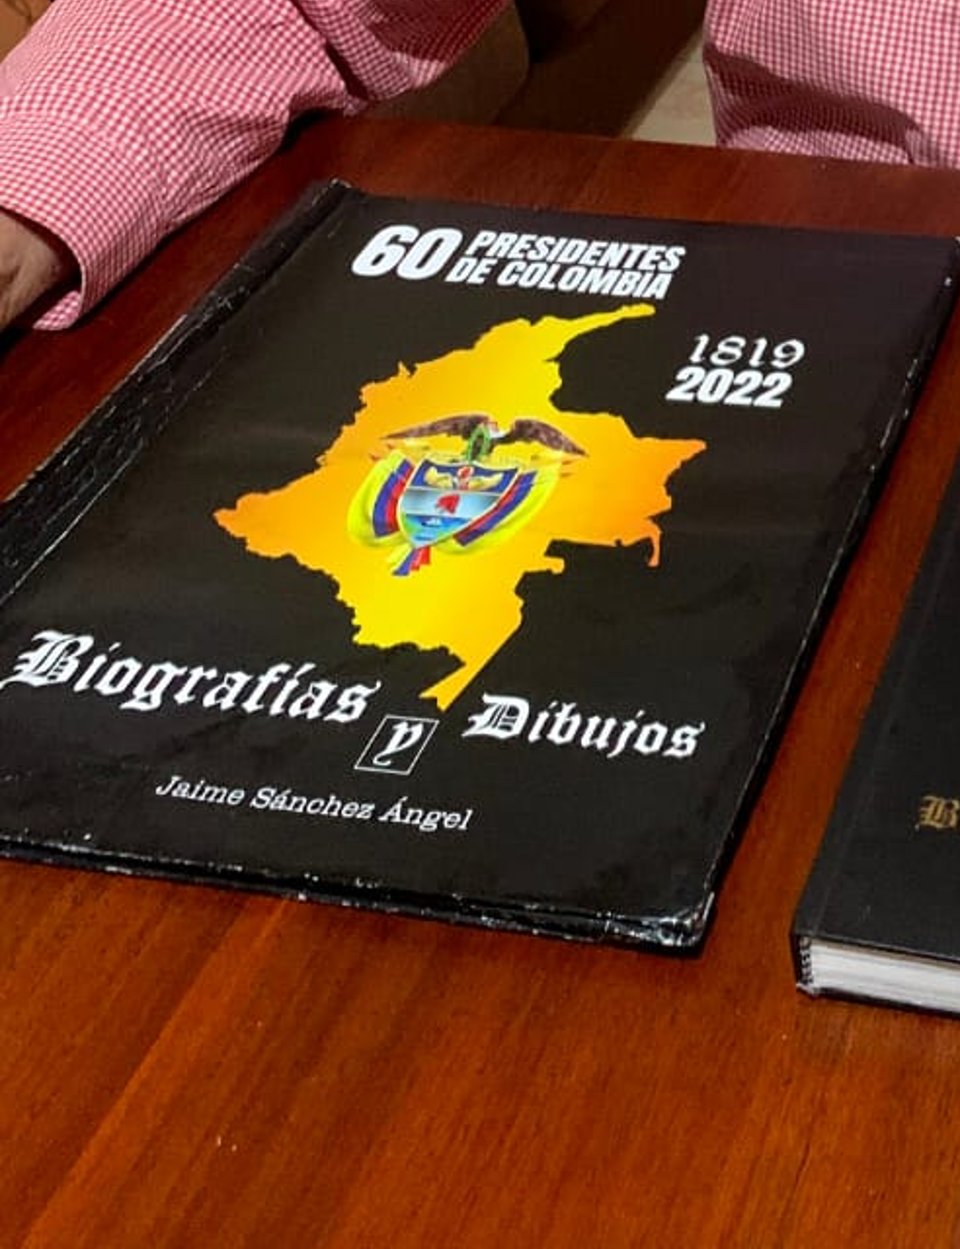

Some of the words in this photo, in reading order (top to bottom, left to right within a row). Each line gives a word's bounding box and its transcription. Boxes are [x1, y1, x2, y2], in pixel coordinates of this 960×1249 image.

[351, 225, 463, 280] 60
[465, 230, 686, 273] PRESIDENTES
[446, 256, 494, 285] DE
[497, 261, 673, 299] COLOMBIA
[688, 333, 805, 368] 1819
[666, 366, 792, 408] 2022
[0, 630, 382, 723] Biografías
[461, 693, 705, 758] Dibujos
[155, 775, 245, 805] Jaime
[250, 787, 375, 821] Sánchez
[378, 796, 473, 832] Ángel
